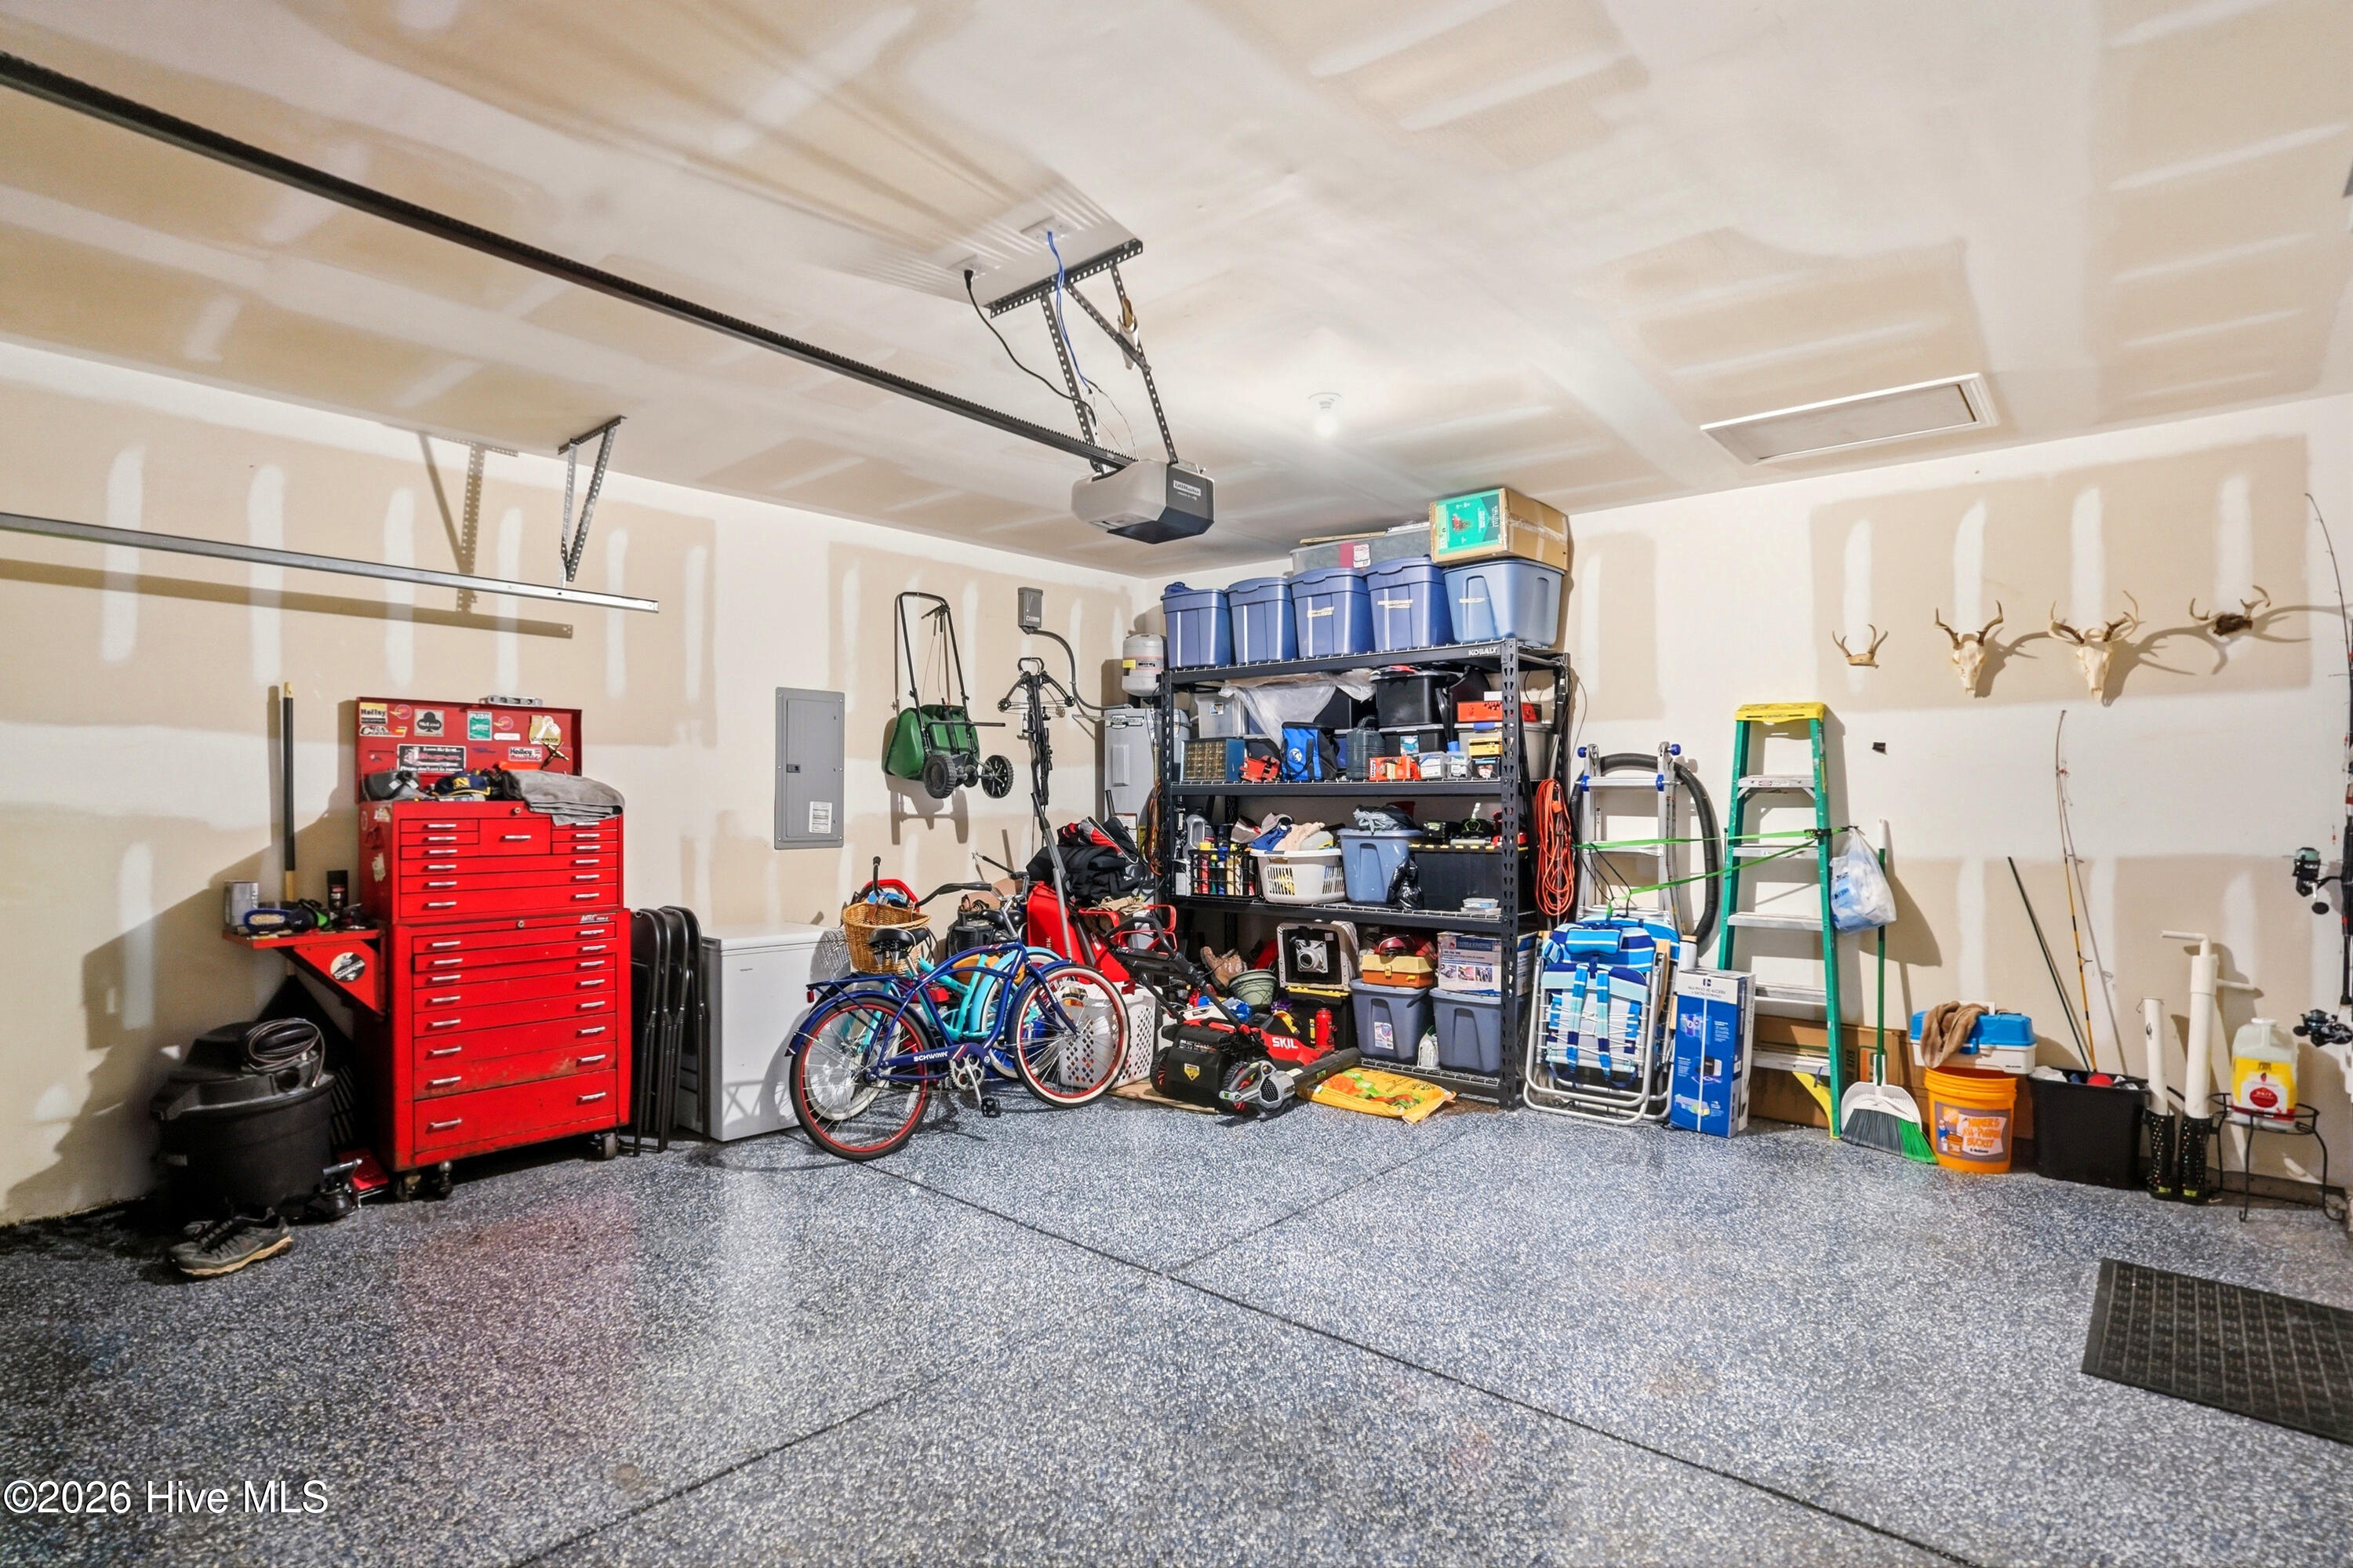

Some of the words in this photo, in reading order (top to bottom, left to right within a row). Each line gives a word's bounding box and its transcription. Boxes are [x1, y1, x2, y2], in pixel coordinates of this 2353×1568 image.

[1468, 646, 1497, 657] KOBALT
[1271, 1037, 1299, 1050] SKIL
[914, 1051, 948, 1062] SCHWINN
